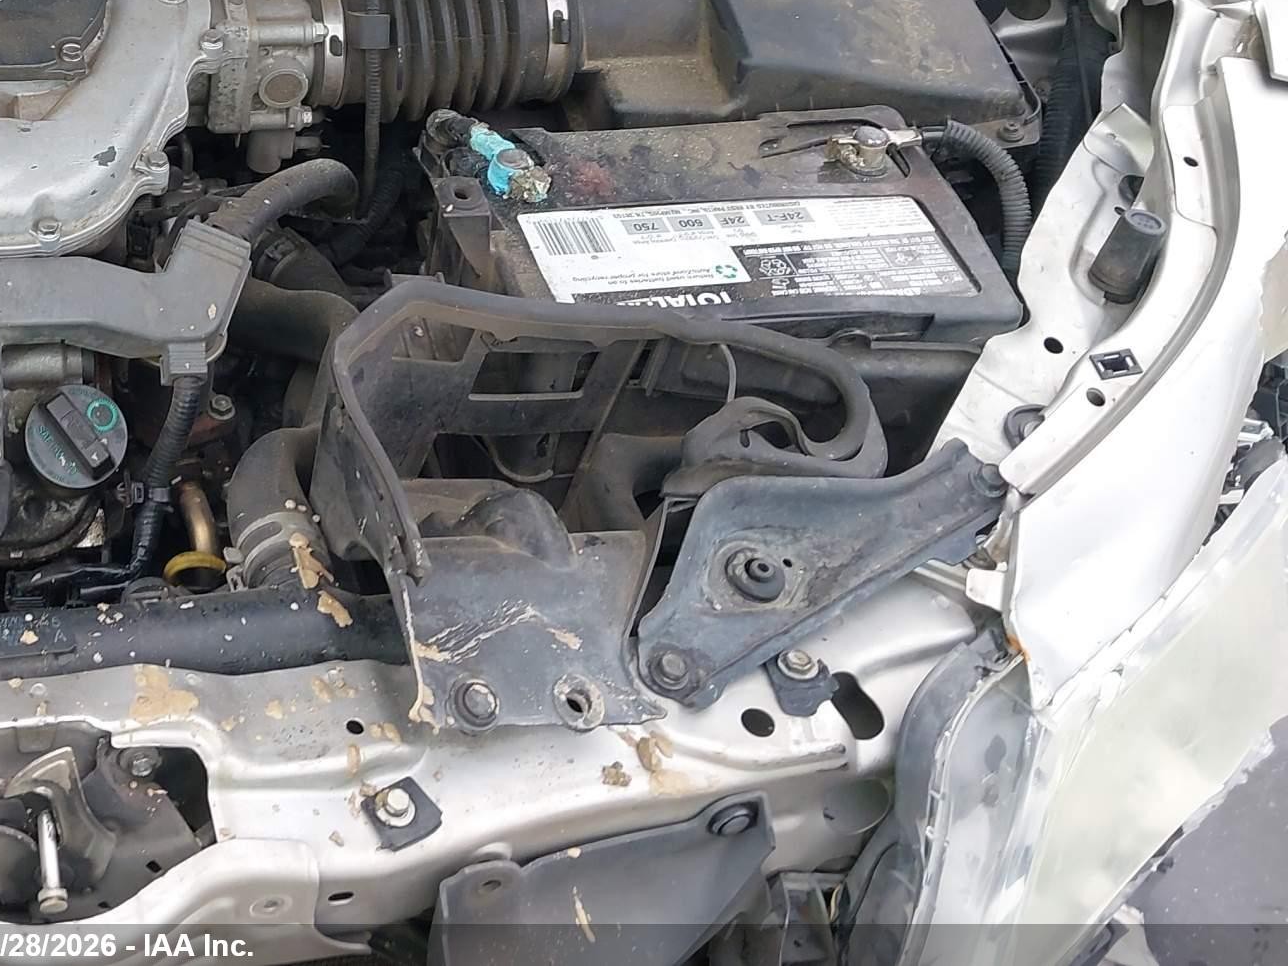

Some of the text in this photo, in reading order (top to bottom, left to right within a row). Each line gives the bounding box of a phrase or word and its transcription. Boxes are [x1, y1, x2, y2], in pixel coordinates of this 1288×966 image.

[720, 215, 745, 225] 24F
[767, 211, 804, 221] 24F-T
[633, 222, 659, 231] 750
